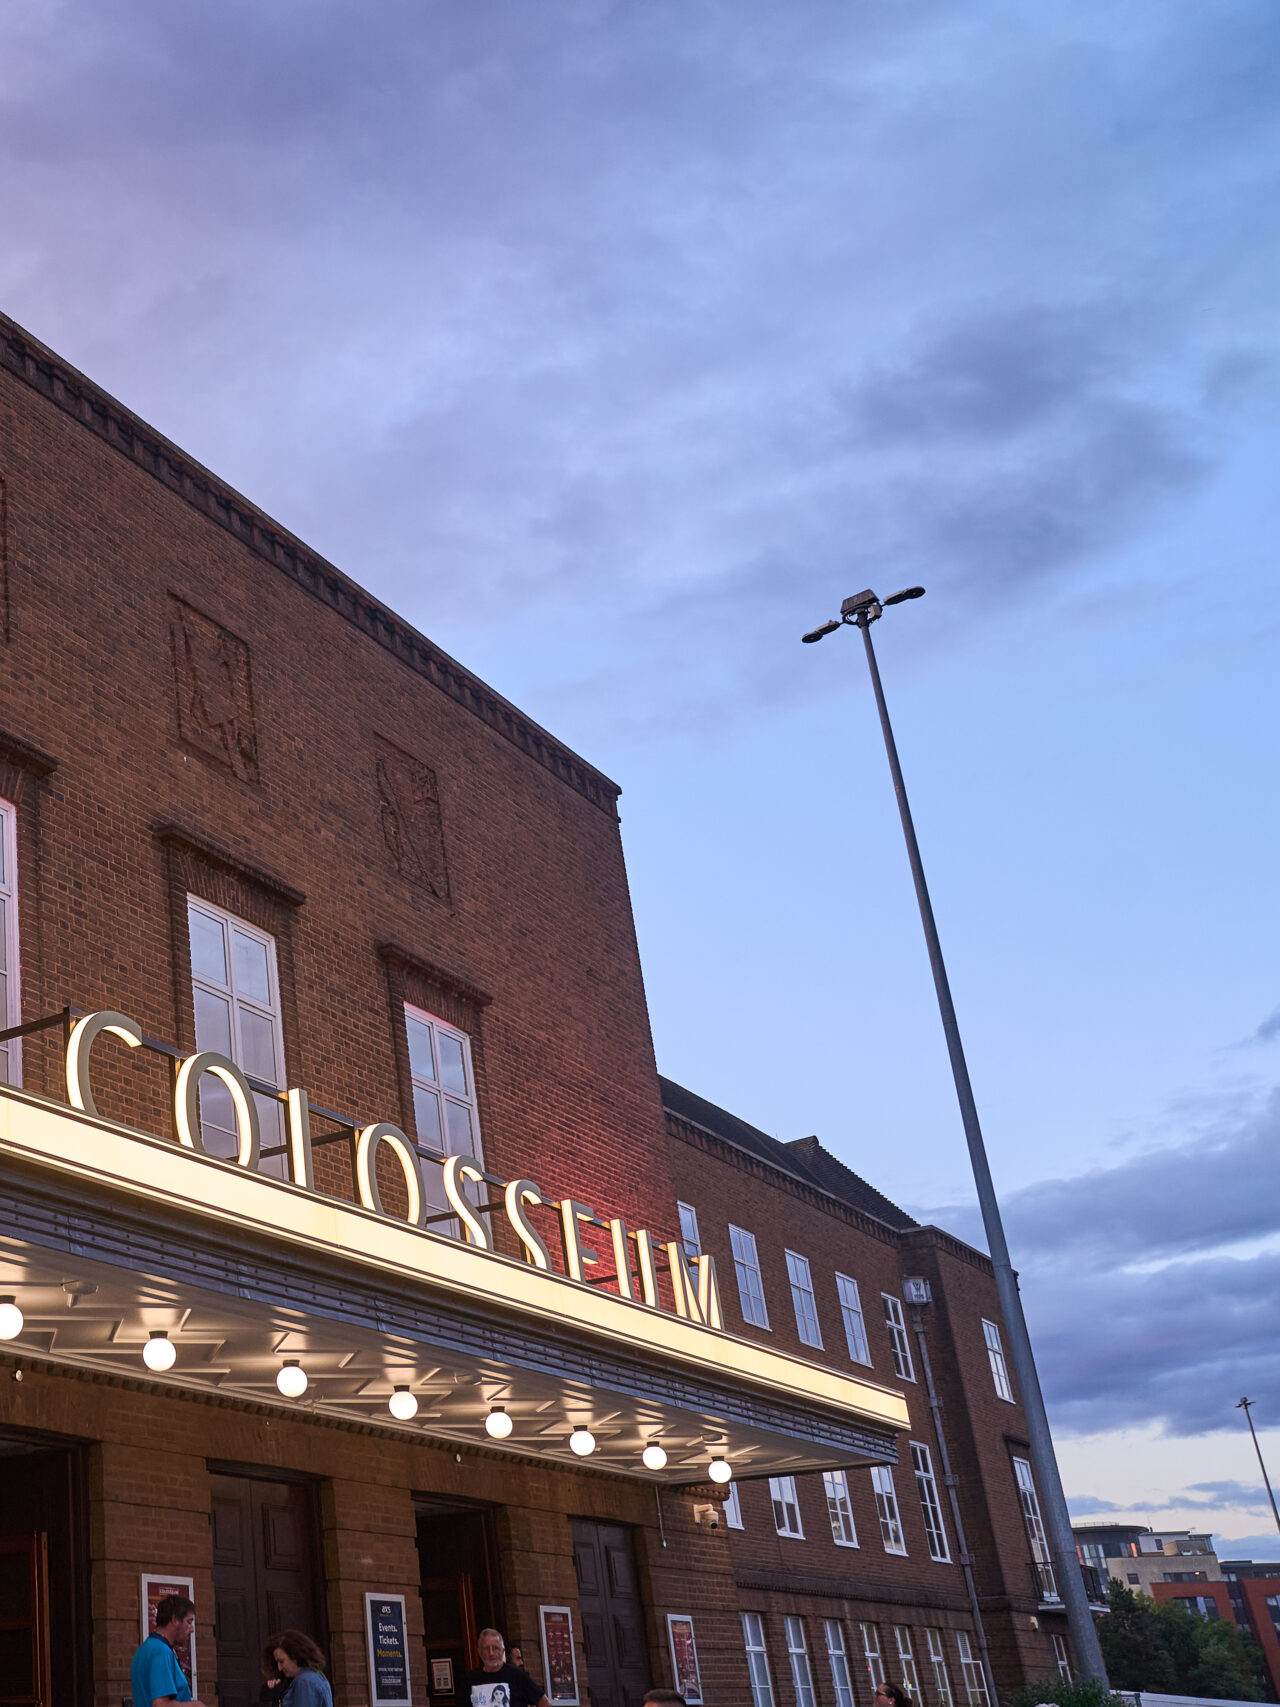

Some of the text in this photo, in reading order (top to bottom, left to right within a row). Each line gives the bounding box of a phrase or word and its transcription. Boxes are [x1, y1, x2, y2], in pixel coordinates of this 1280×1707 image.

[65, 1009, 725, 1331] COLOSSEUM
[378, 1622, 398, 1633] Events.
[378, 1635, 400, 1645] Tickets.
[377, 1648, 403, 1658] Moments.
